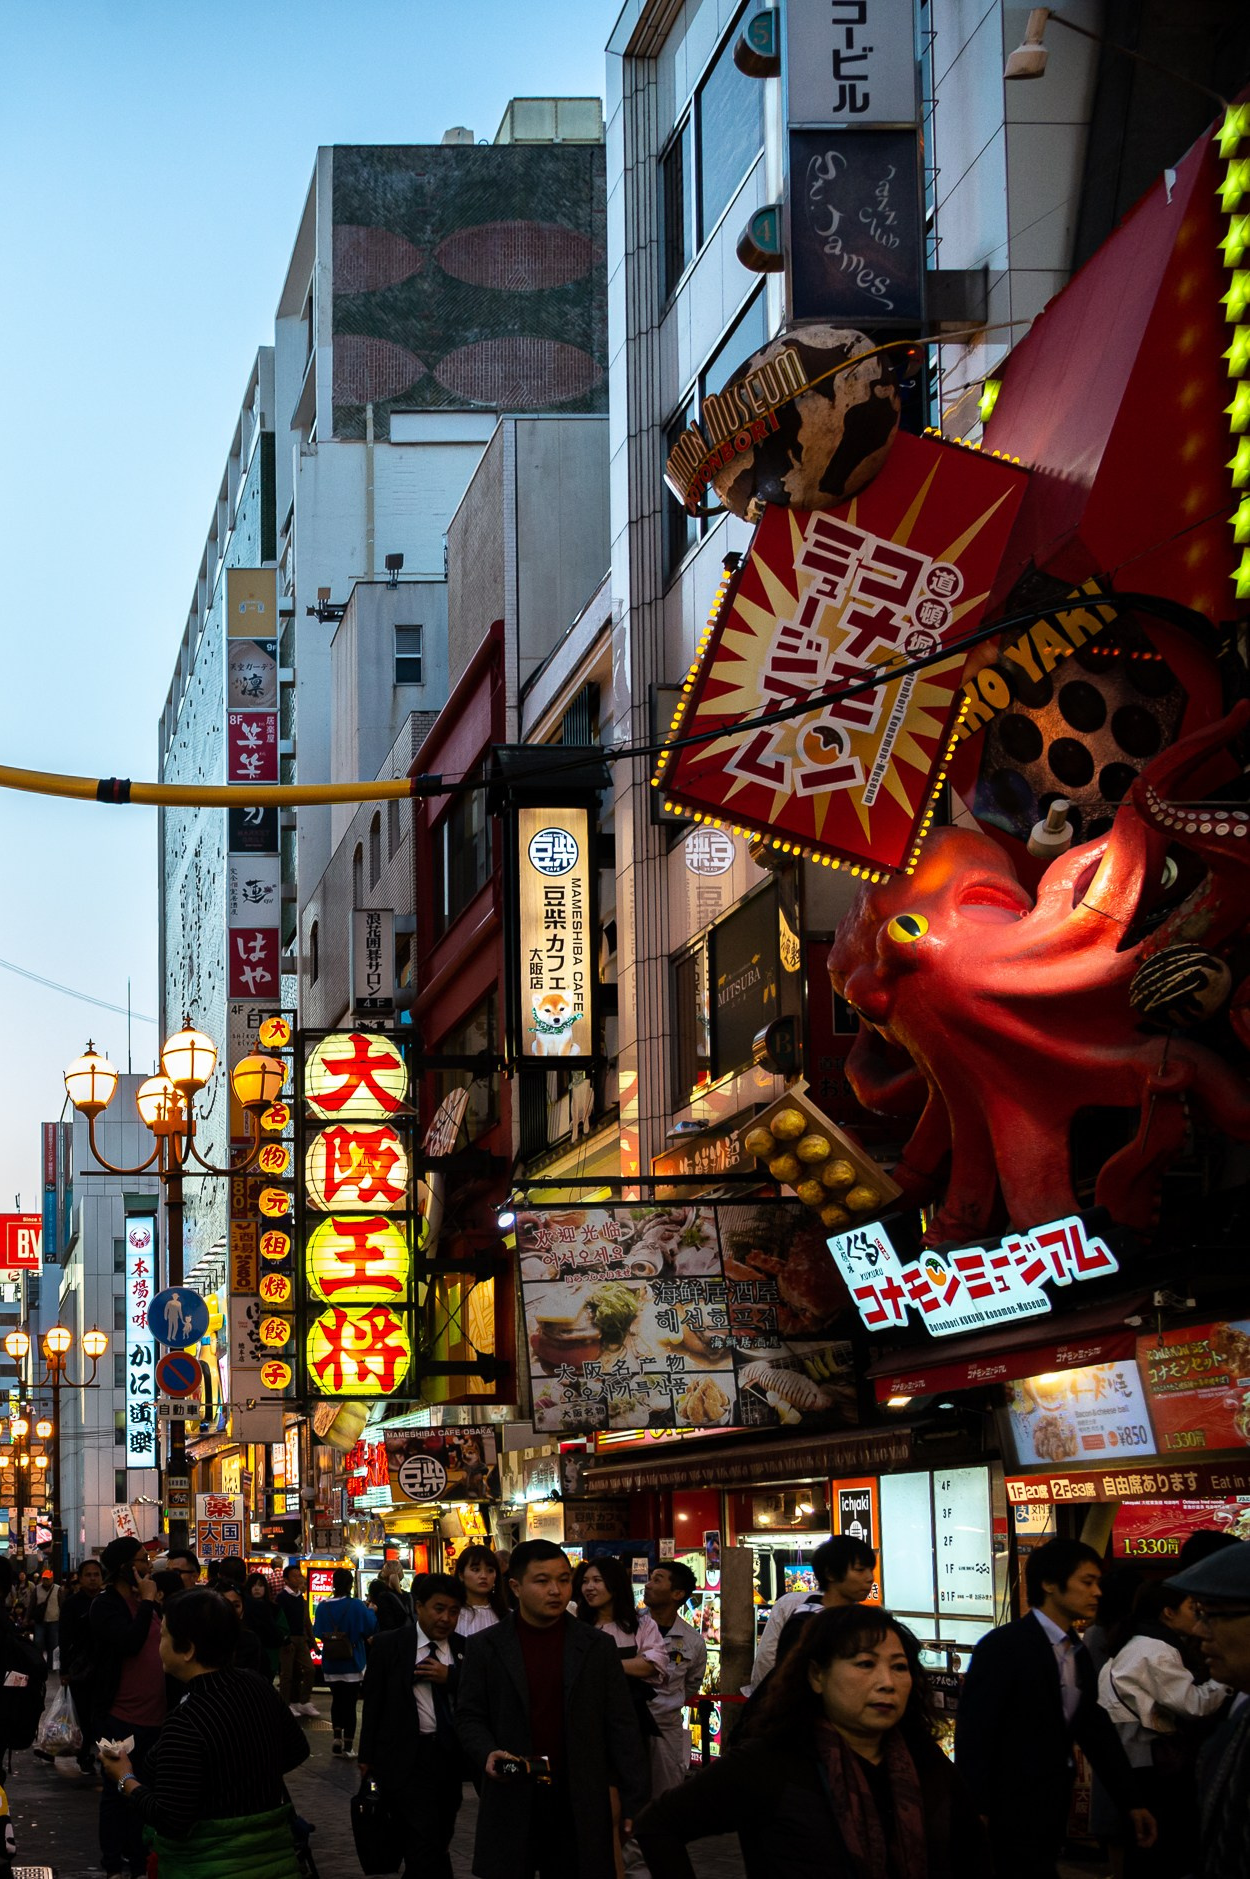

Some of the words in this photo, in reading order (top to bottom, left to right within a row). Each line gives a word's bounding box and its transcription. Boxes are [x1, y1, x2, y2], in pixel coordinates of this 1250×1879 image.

[753, 22, 769, 44] 5
[756, 219, 771, 243] 4
[702, 346, 809, 445] MUSEUM
[229, 715, 243, 725] 8F
[571, 877, 584, 966] MAMESHIBA
[544, 885, 567, 990] 豆柴カフェ
[366, 912, 383, 997] 浪花囲碁サロン
[529, 947, 544, 989] 大阪店
[573, 971, 584, 1012] CAFE
[306, 1033, 408, 1392] 大阪王将
[534, 1221, 621, 1249] 欢迎光临
[542, 1245, 627, 1271] 어서오세요
[853, 1224, 1113, 1325] コナモンミュージアム
[130, 1257, 150, 1330] 本場の味
[960, 1311, 985, 1327] KUKURU
[159, 1403, 198, 1417] 自動車
[386, 1430, 435, 1439] MAMESHIBA
[437, 1429, 461, 1437] CAFE
[463, 1428, 492, 1436] OSAKA
[941, 1480, 951, 1491] 4F
[1010, 1483, 1024, 1499] 1F
[1026, 1484, 1049, 1499] 20席
[1071, 1481, 1097, 1497] 33席
[1102, 1471, 1198, 1496] 自由席あります
[1211, 1474, 1233, 1490] Eat
[1234, 1473, 1246, 1489] in
[205, 1496, 235, 1519] 薬
[942, 1508, 952, 1518] 3F
[201, 1522, 239, 1542] 大国
[944, 1536, 953, 1546] 2F
[1124, 1538, 1179, 1555] 1,330円
[945, 1563, 954, 1574] 1F
